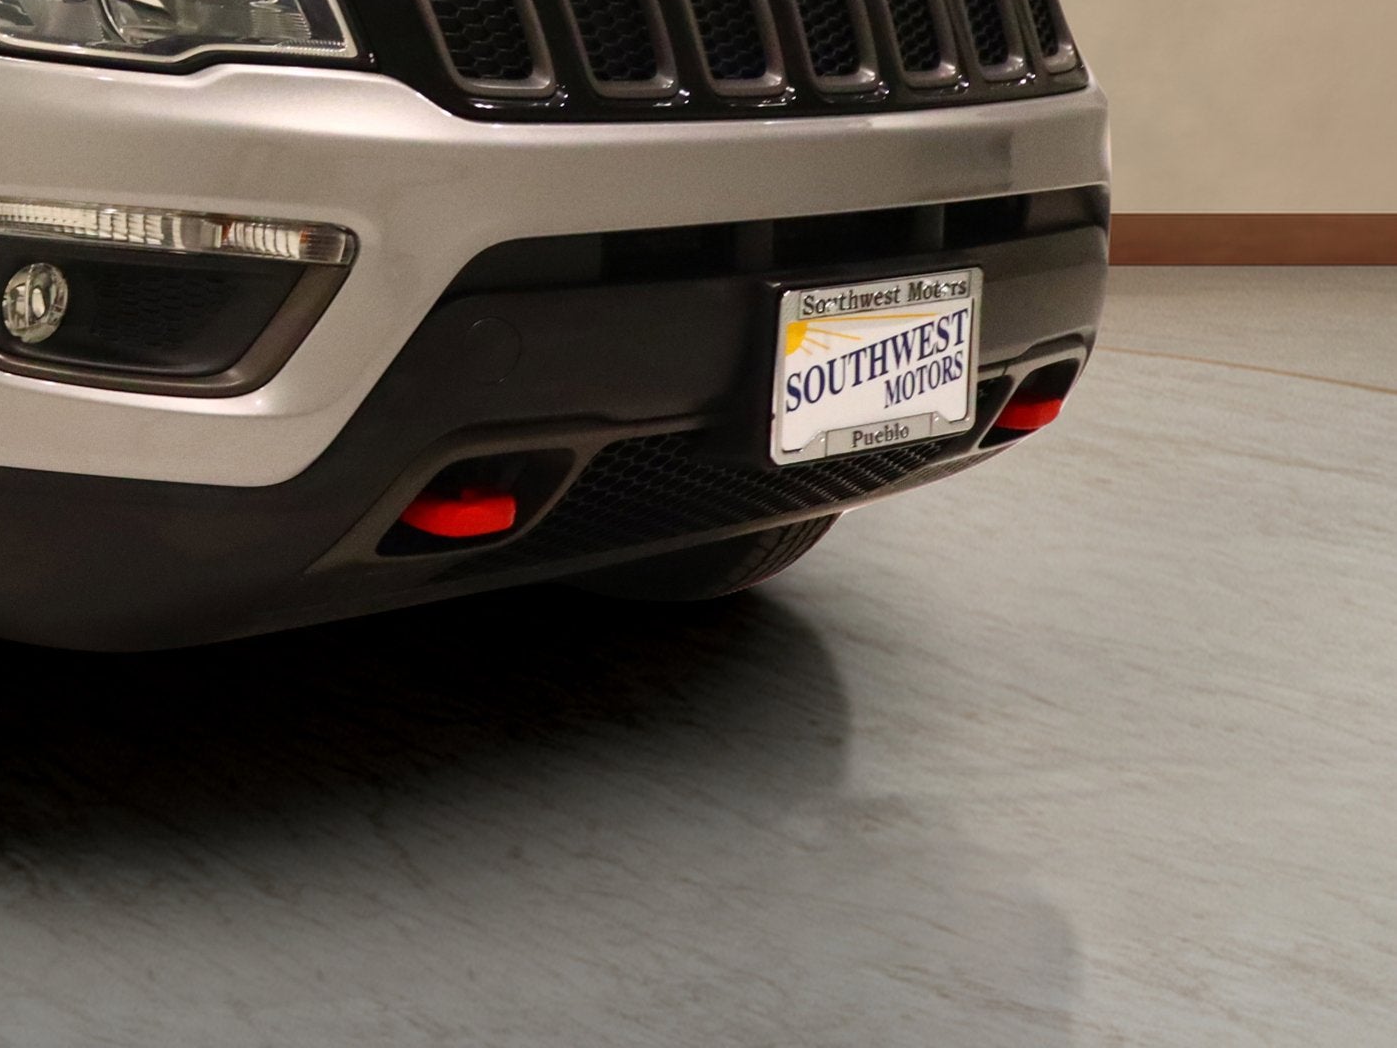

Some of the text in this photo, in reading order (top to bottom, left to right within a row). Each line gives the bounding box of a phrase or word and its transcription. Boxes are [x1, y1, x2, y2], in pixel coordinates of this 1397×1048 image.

[785, 308, 969, 413] SOUTHWEST
[884, 350, 964, 409] MOTORS
[851, 422, 910, 448] Pueblo
